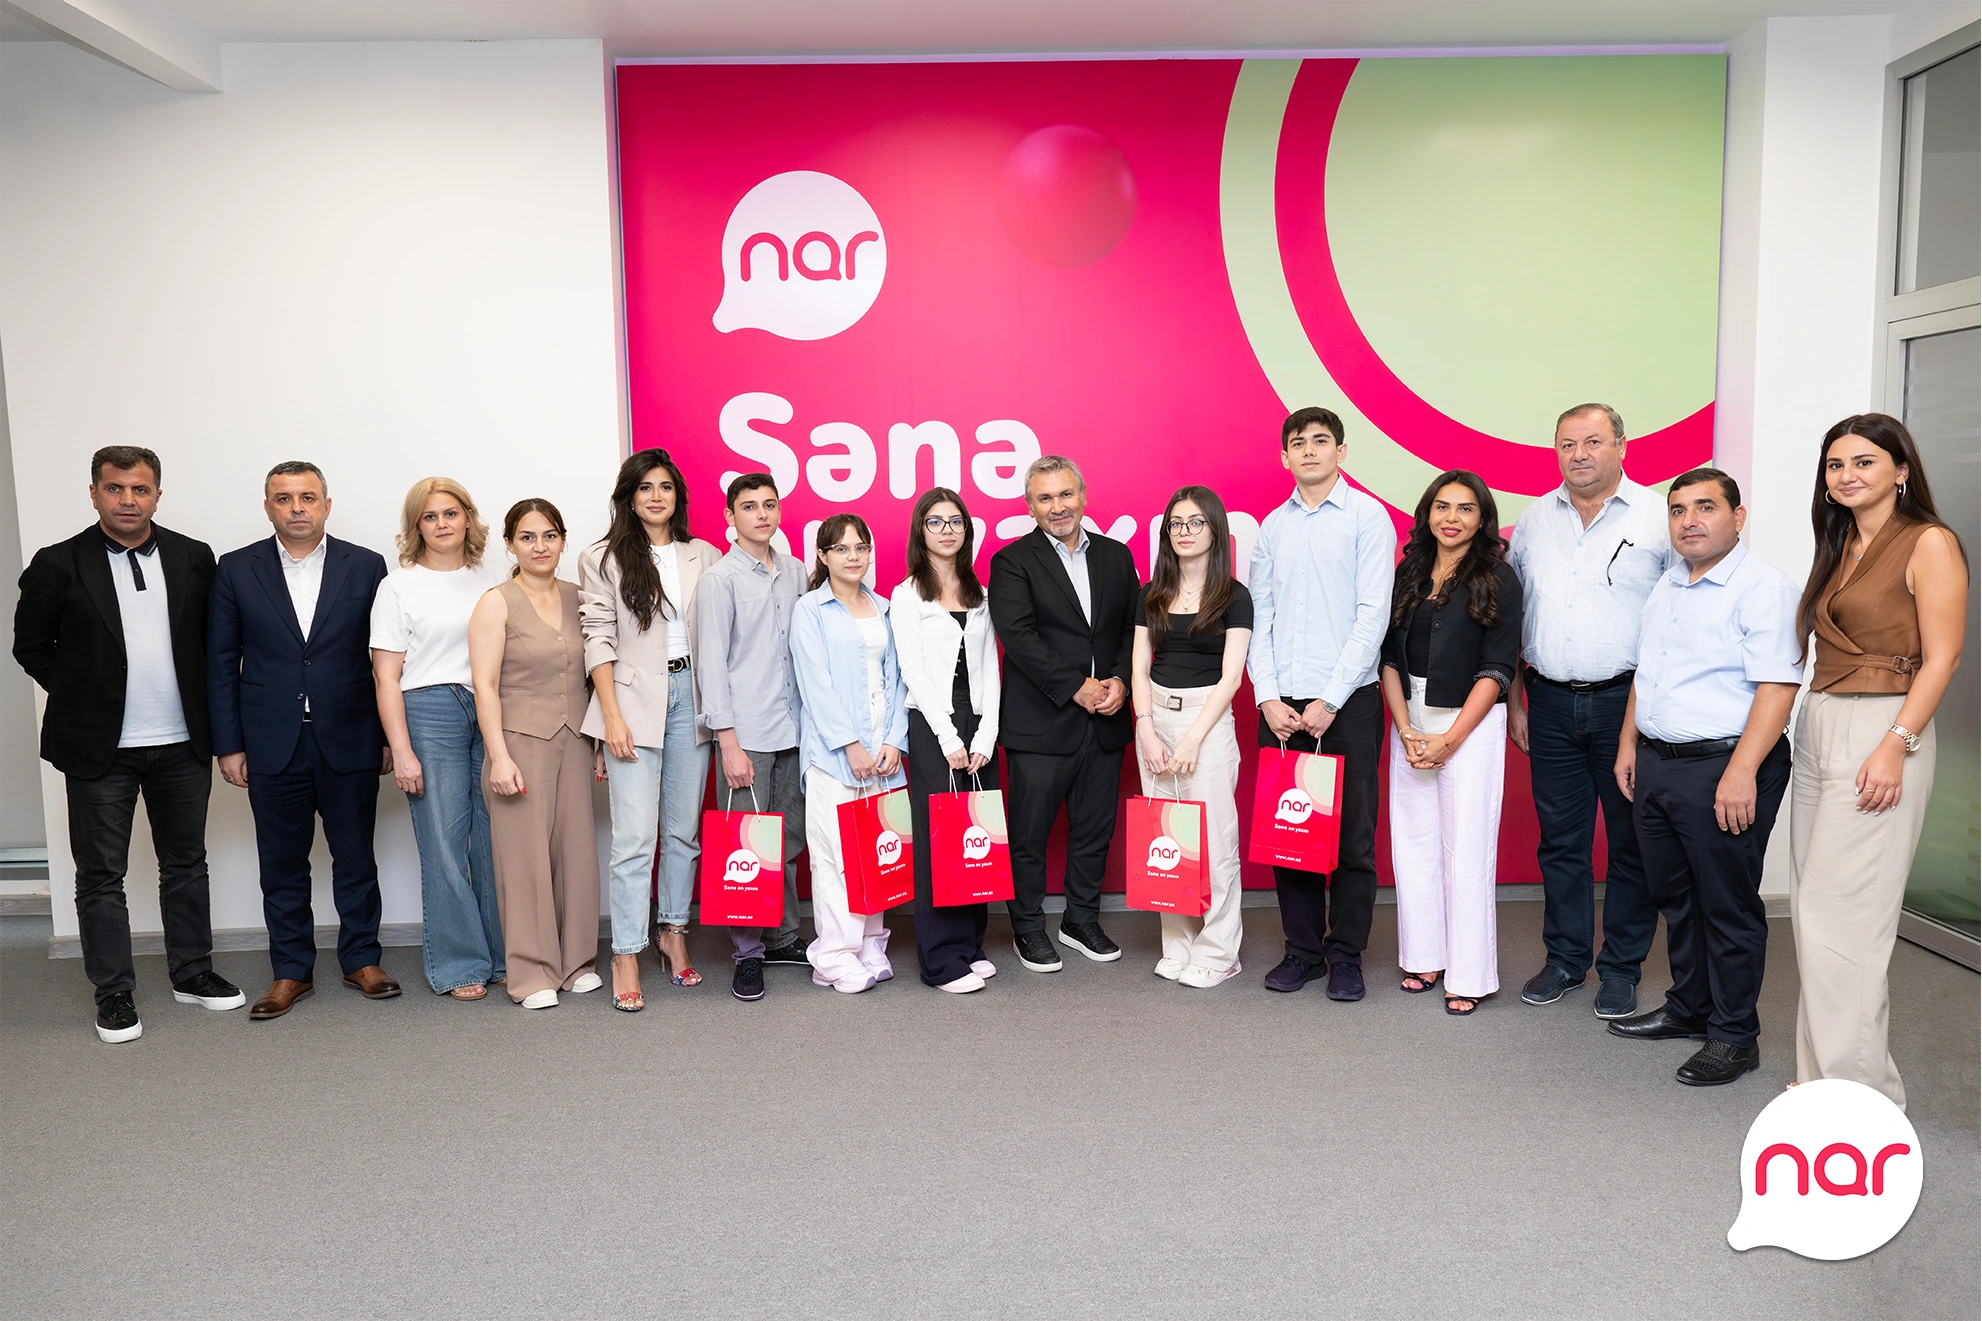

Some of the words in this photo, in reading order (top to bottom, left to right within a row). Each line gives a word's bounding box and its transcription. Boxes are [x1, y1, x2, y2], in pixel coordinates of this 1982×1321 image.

[740, 230, 879, 281] nar
[718, 391, 1041, 500] Sənə
[1281, 800, 1310, 812] nar
[879, 839, 899, 855] nar
[966, 837, 988, 848] nar
[1152, 847, 1178, 859] nar
[729, 860, 758, 871] nar
